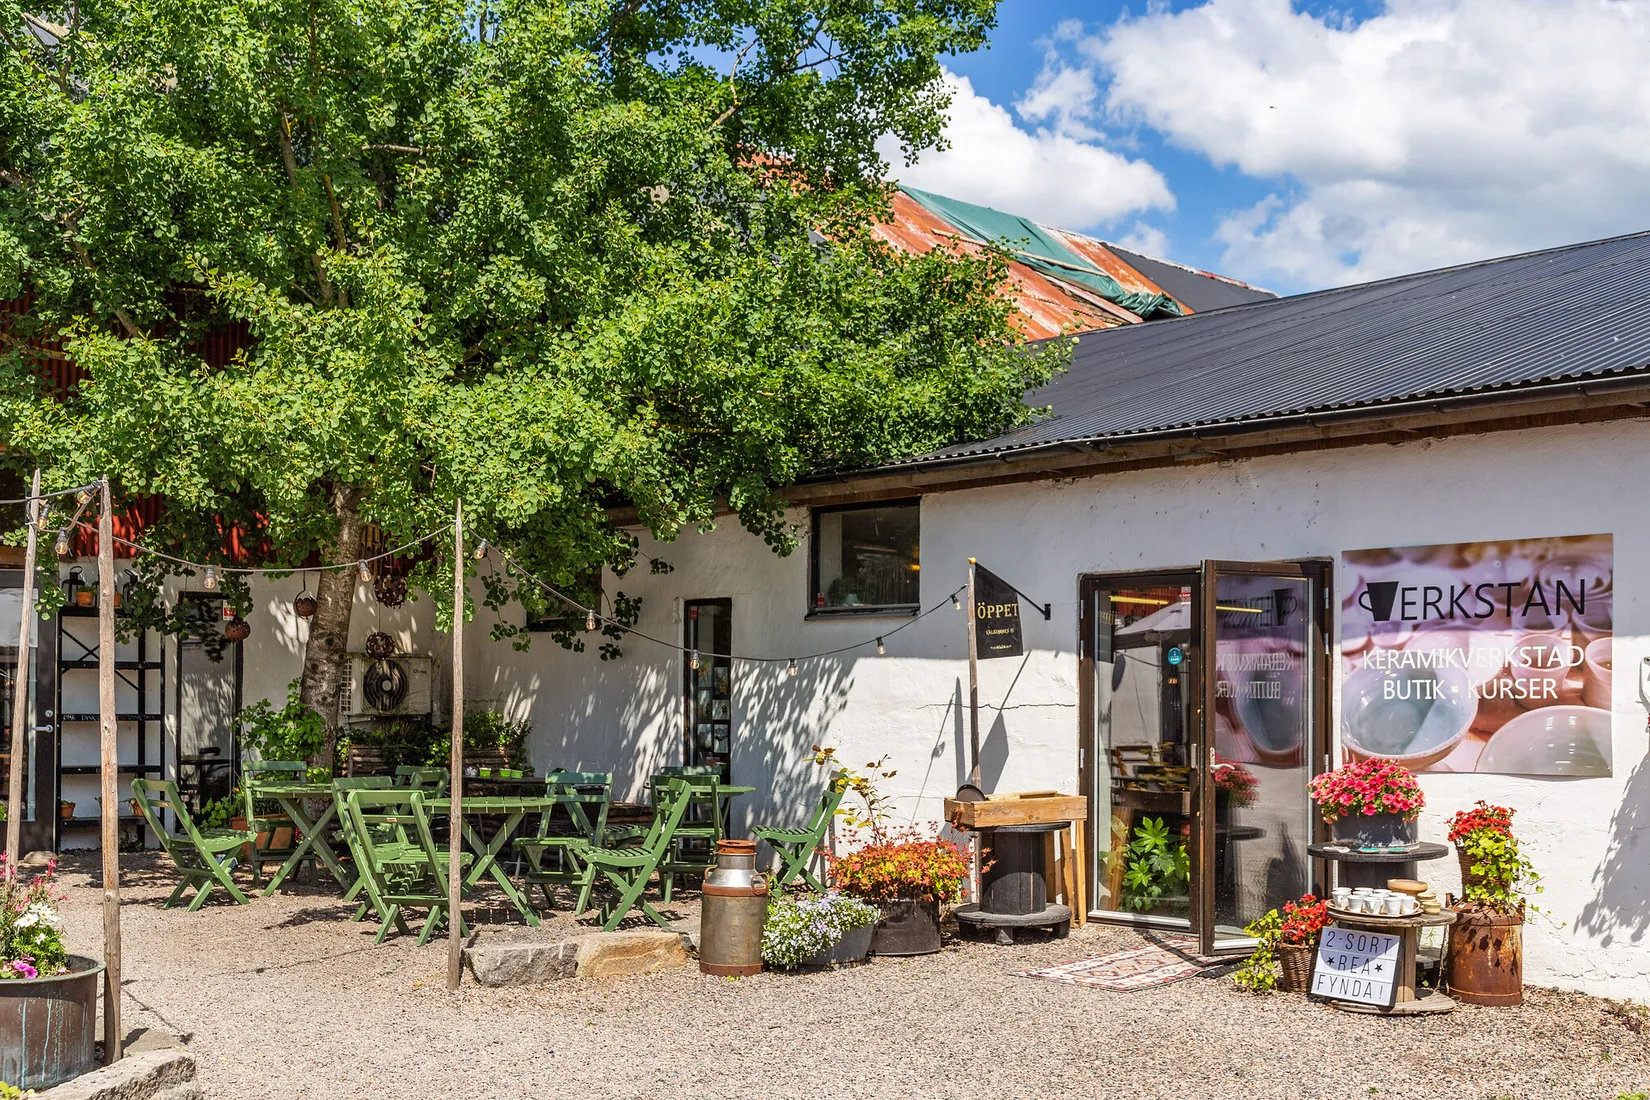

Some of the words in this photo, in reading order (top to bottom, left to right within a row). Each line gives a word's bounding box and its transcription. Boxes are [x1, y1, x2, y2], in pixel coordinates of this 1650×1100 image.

[977, 601, 1018, 619] ÖPPET
[1362, 645, 1585, 670] KERAMIKVERKSTAD
[1383, 678, 1447, 700] BUTIK
[1467, 677, 1559, 700] KURSER
[1326, 930, 1393, 956] 2-SORT
[1337, 954, 1370, 976] REA
[1316, 974, 1384, 1000] FYNDA!
